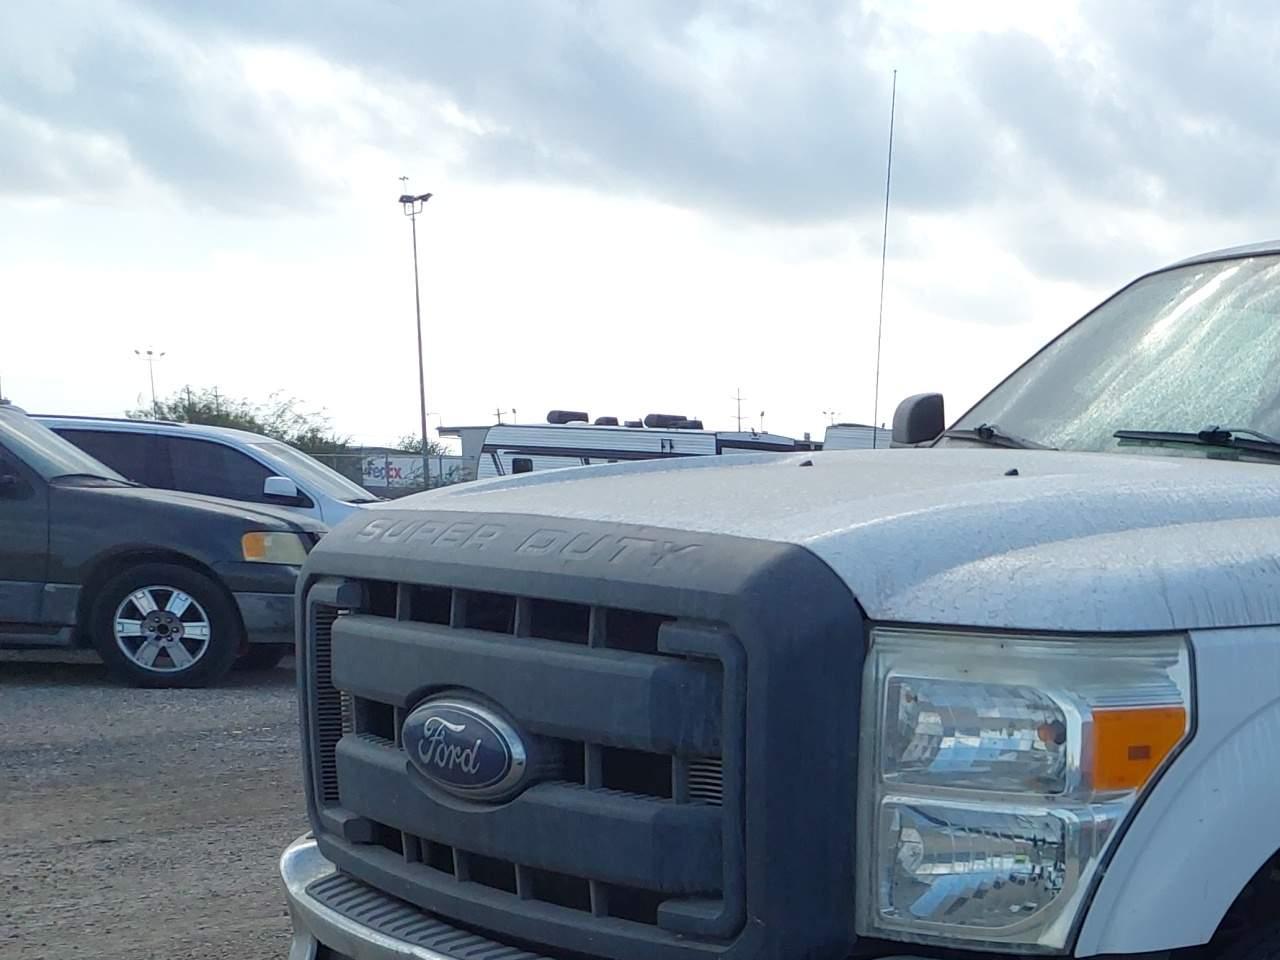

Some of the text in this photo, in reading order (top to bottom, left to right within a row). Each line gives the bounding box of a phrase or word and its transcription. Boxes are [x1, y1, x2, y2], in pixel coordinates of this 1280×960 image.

[357, 517, 704, 567] SUPER DUTY
[418, 716, 481, 774] Ford
